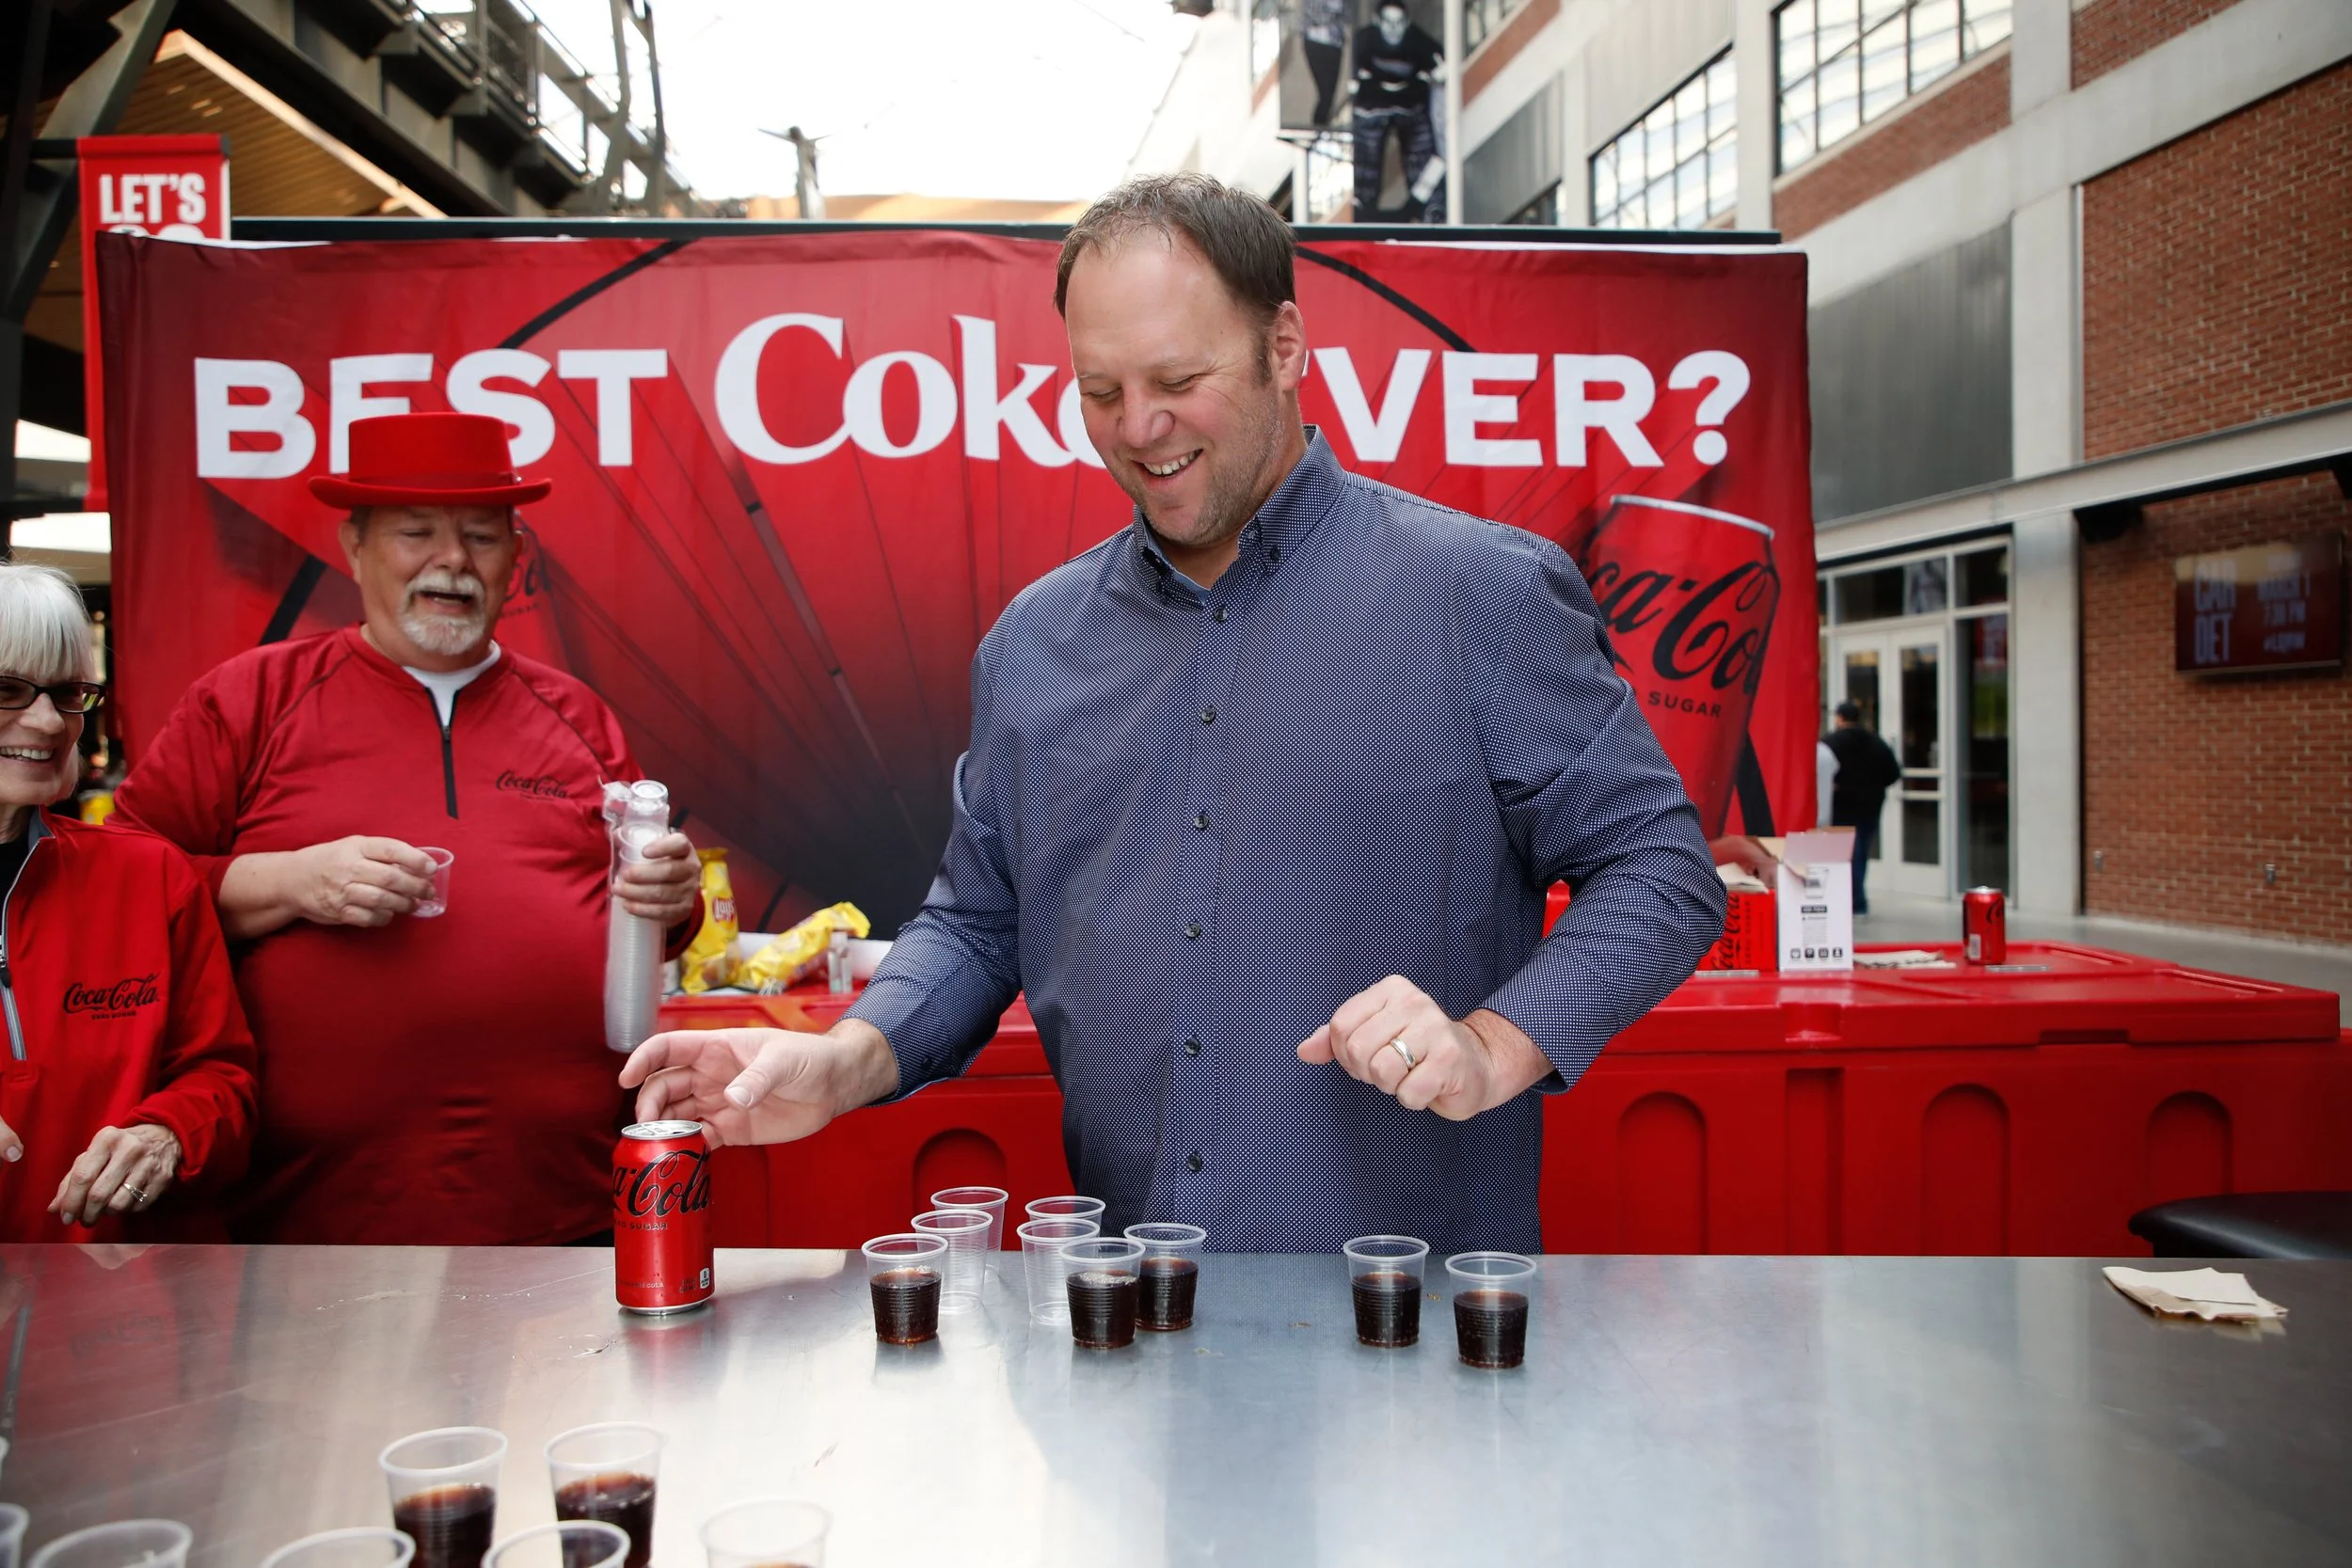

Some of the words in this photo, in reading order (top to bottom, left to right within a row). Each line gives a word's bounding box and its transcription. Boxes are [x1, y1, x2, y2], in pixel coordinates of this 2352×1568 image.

[100, 172, 206, 225] LET'S
[1302, 347, 1751, 467] VER?
[1647, 689, 1723, 719] SUGAR
[63, 972, 161, 1015] Coca-Cola
[630, 1222, 668, 1231] SUGAR
